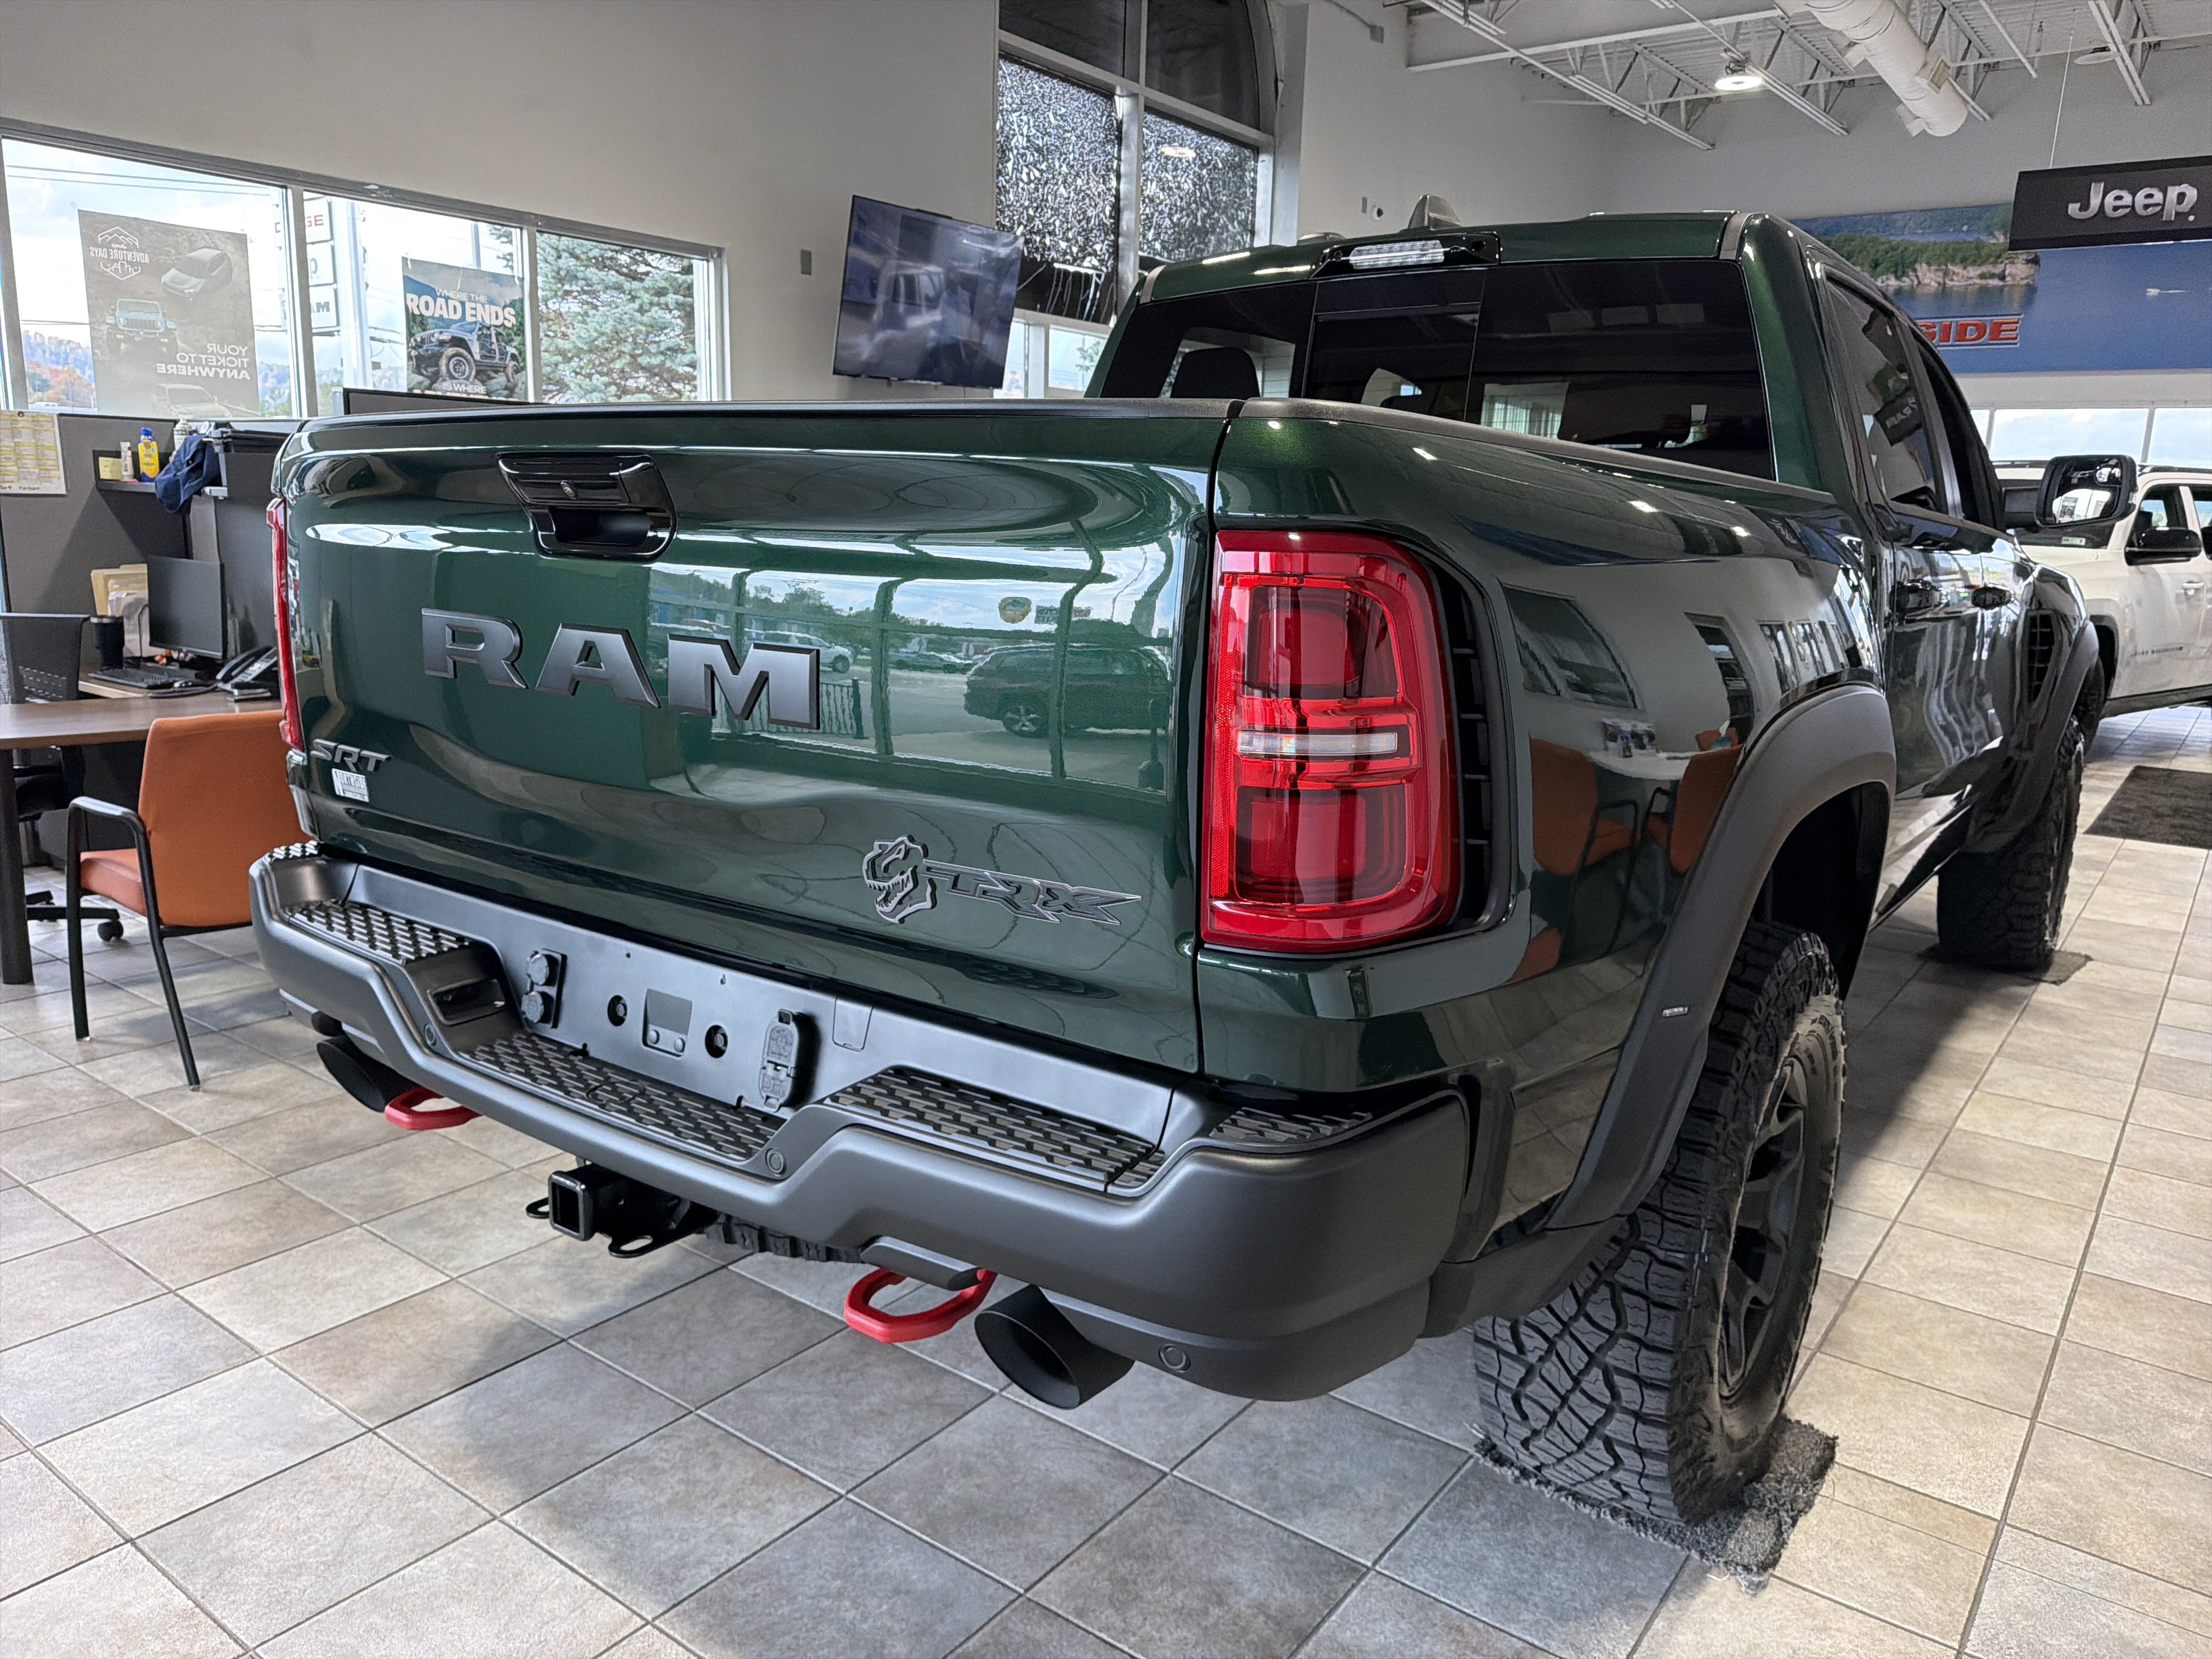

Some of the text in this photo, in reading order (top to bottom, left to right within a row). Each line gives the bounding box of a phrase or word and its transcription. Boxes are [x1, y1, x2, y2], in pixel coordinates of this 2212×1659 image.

[406, 293, 516, 328] ROAD ENDS
[436, 287, 488, 302] WHERE THE
[442, 382, 452, 391] IS
[454, 382, 487, 394] WHERE
[421, 607, 821, 730] RAM
[310, 738, 393, 772] SRT
[919, 859, 1143, 926] TRX
